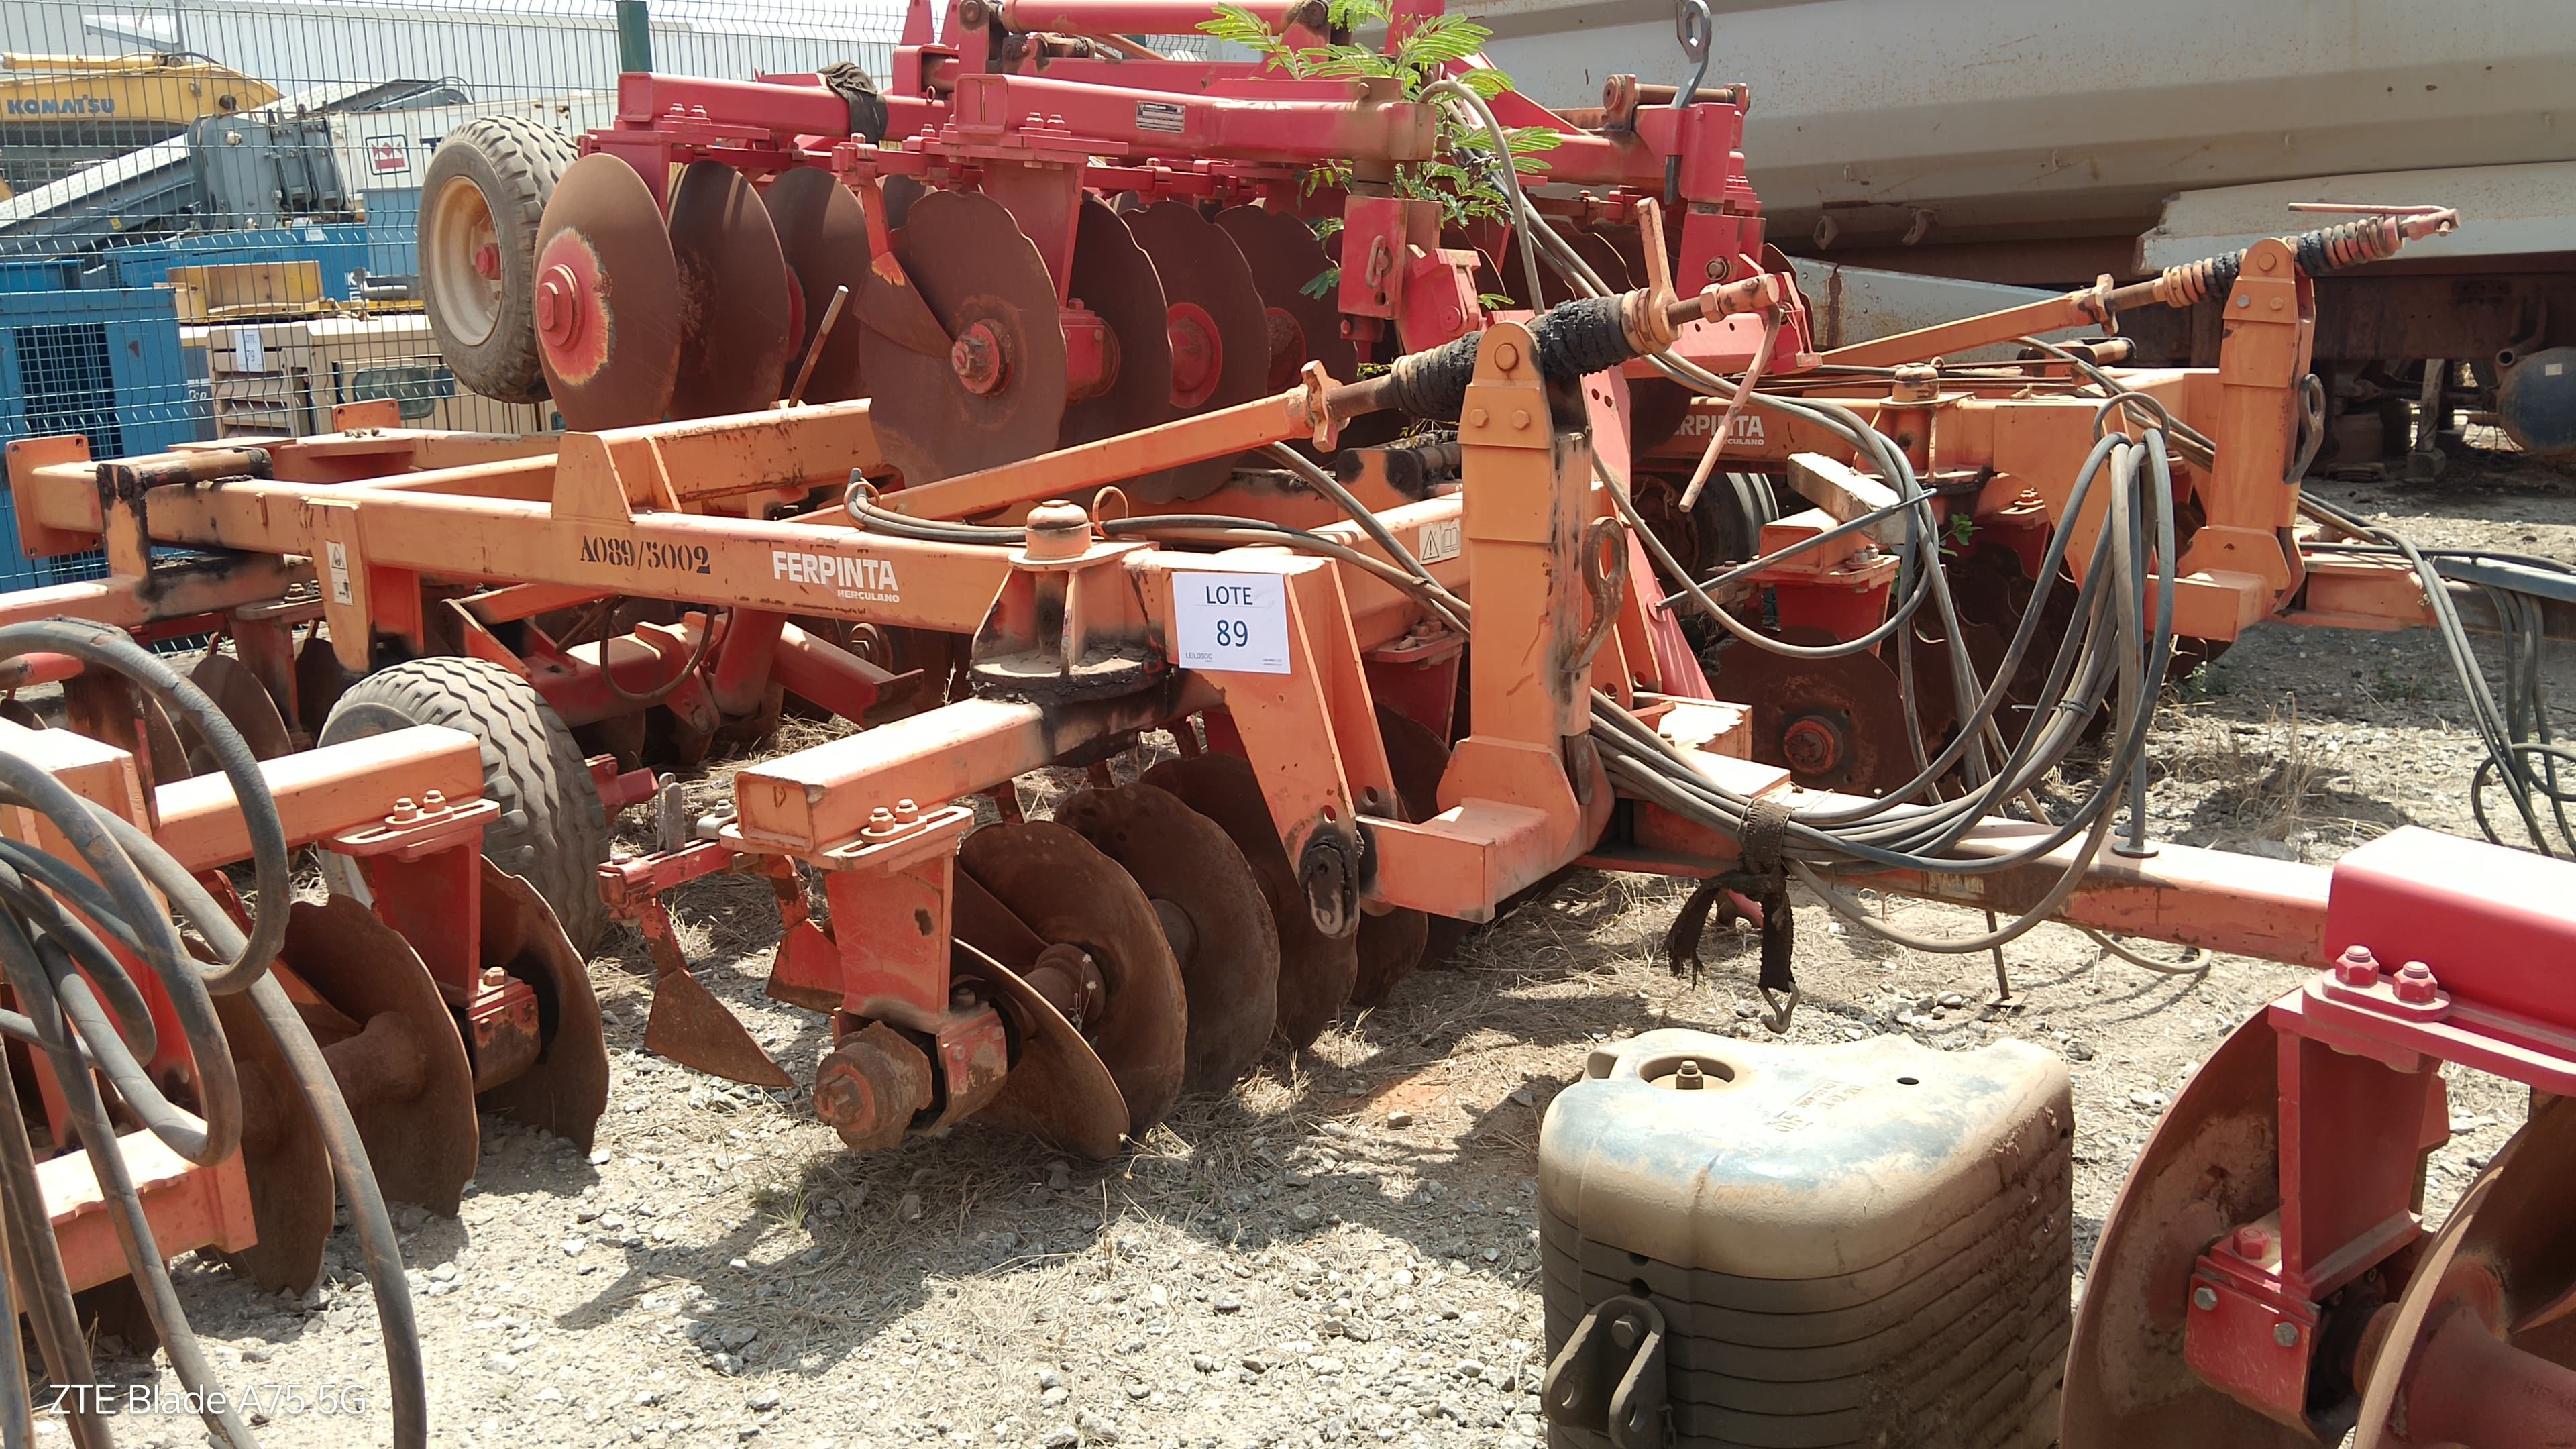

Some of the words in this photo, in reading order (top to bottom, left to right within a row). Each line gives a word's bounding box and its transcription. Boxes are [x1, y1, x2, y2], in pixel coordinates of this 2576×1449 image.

[7, 94, 115, 114] KOMATSU
[1674, 415, 1764, 437] RPITA
[1709, 437, 1764, 445] CULANO
[580, 535, 711, 574] A089/5002
[772, 550, 899, 591] FERPINTA
[837, 589, 900, 603] HERCULANO
[1206, 586, 1253, 606] LOTE
[1217, 619, 1248, 647] 89
